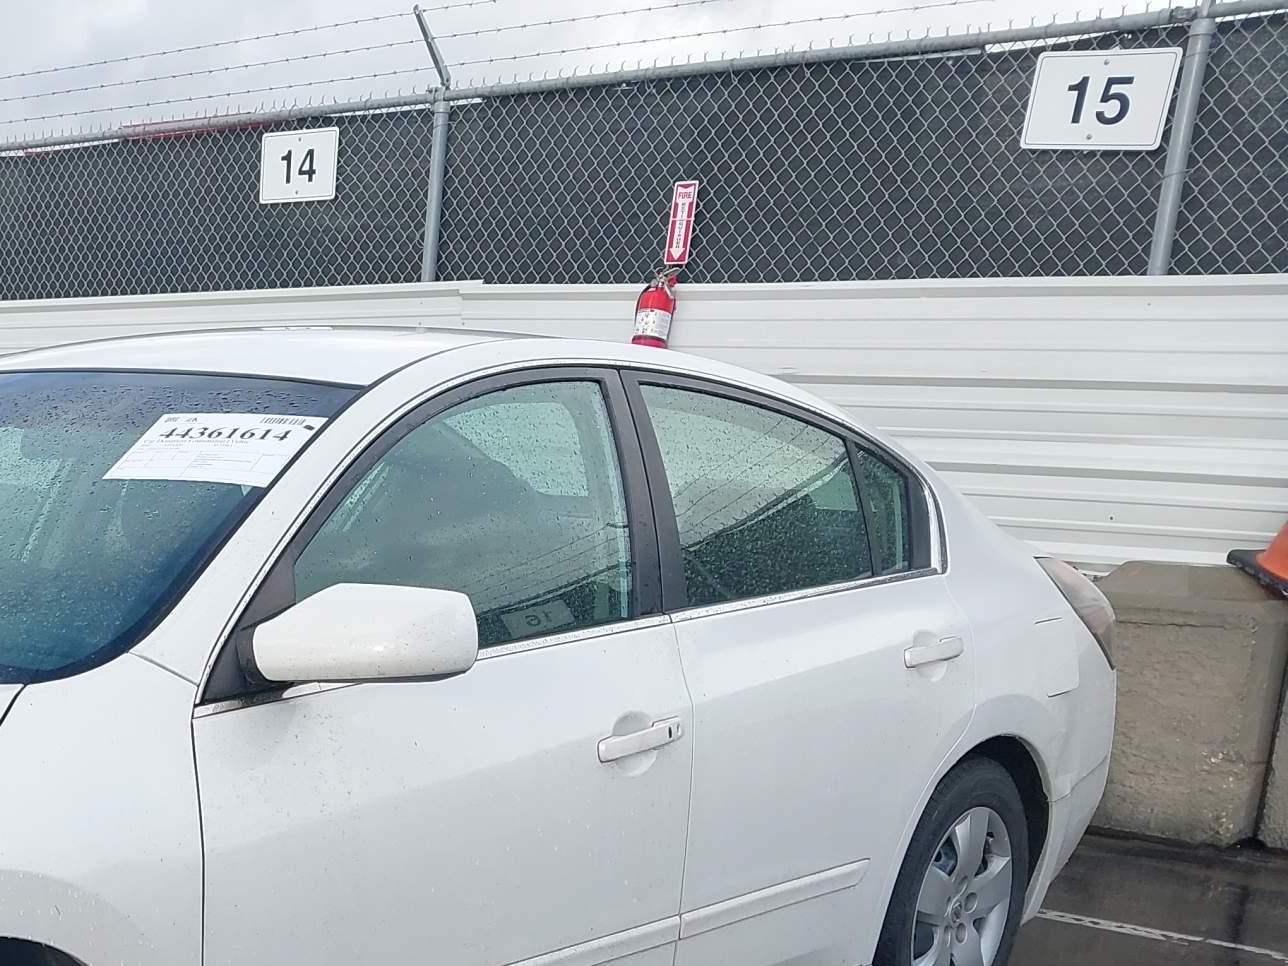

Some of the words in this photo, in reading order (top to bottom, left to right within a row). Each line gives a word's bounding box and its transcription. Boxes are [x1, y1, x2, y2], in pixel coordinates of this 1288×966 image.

[1067, 76, 1135, 125] 15
[280, 148, 316, 184] 14
[678, 191, 693, 199] FIRE
[159, 426, 292, 441] 44361614
